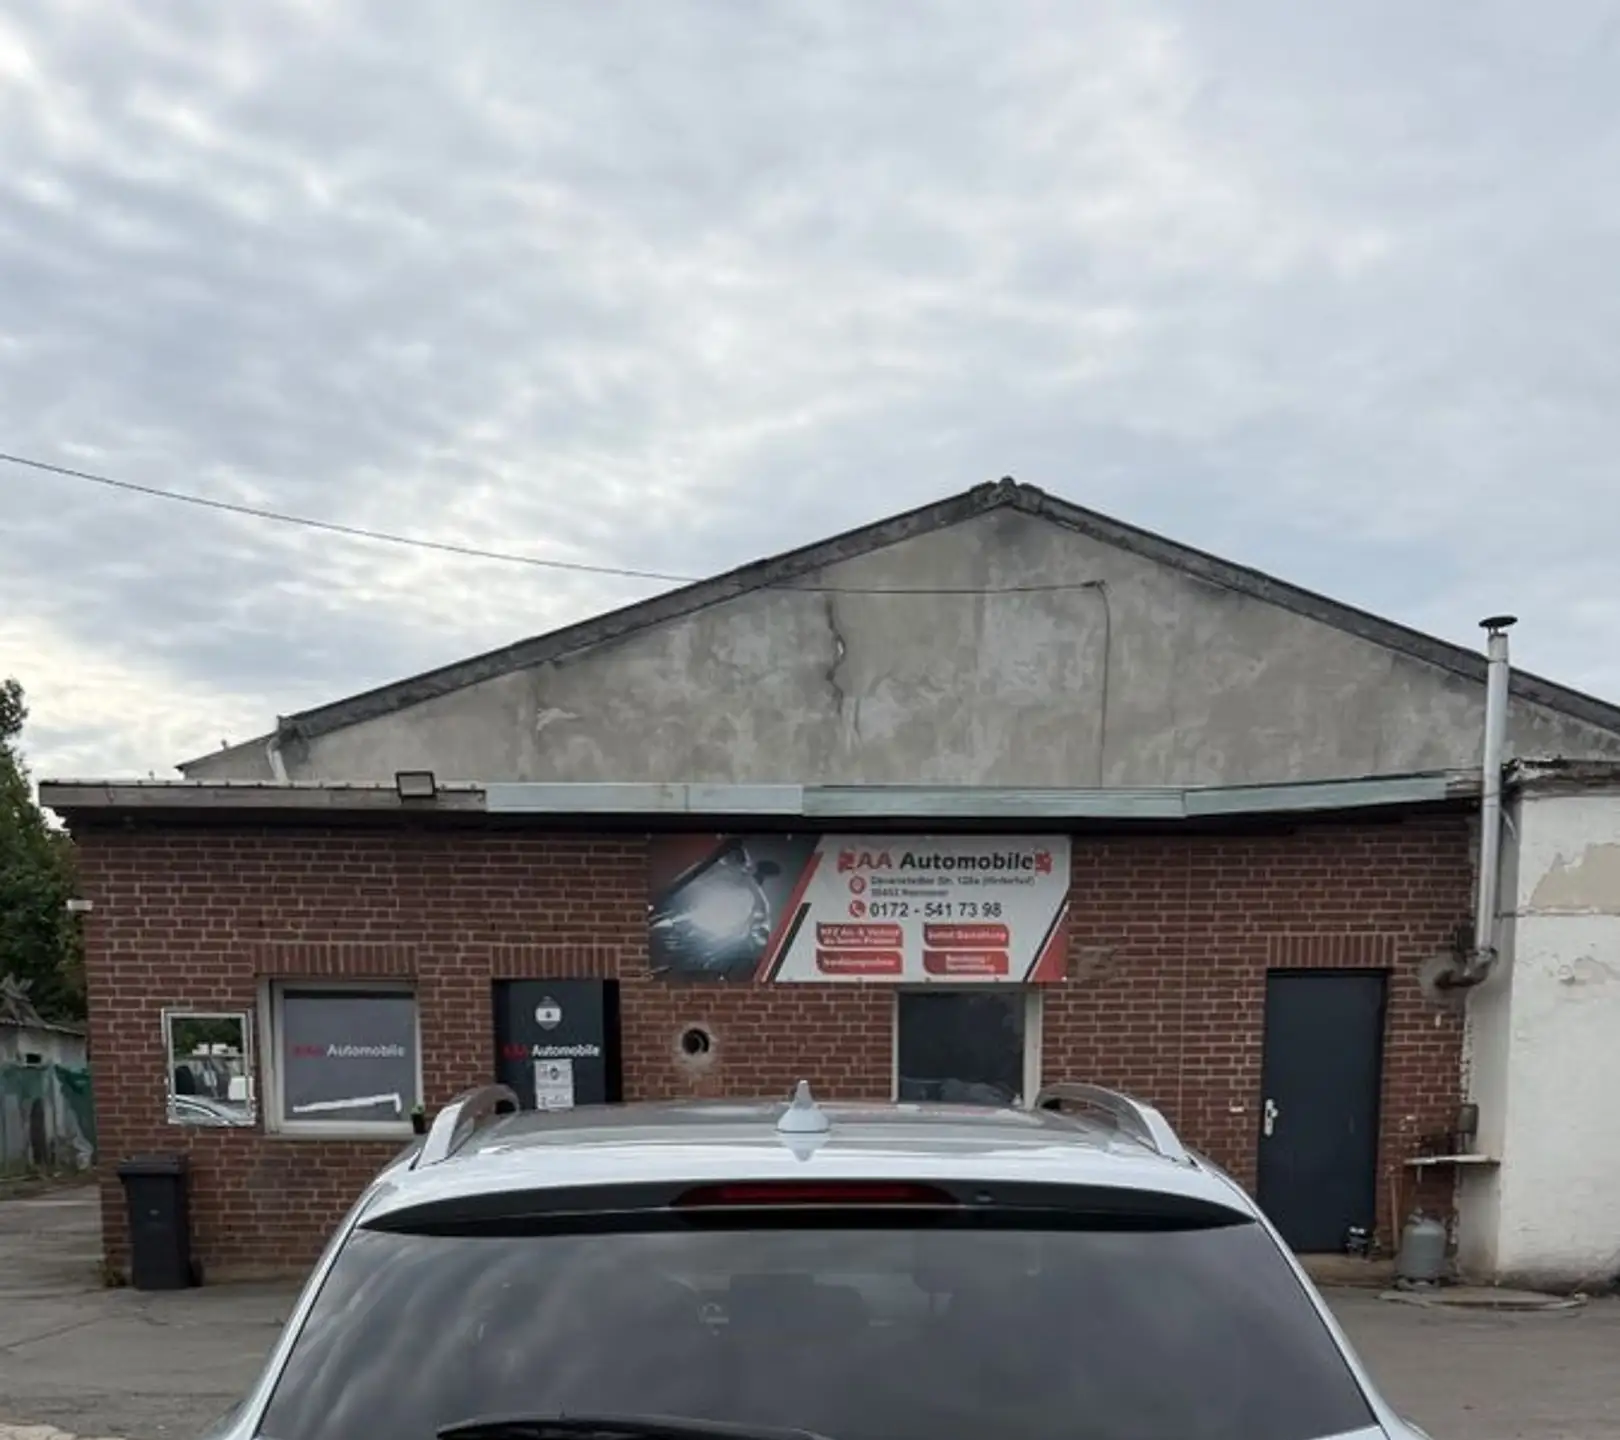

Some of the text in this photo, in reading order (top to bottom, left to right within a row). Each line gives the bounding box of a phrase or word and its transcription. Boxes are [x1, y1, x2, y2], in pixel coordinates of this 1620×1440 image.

[856, 851, 1034, 870] AA Automobile
[869, 902, 909, 917] 0172
[924, 902, 951, 917] 541
[959, 902, 978, 917] 73
[982, 902, 1001, 917] 98
[326, 1043, 405, 1057] Automobile
[532, 1043, 600, 1057] Automobile
